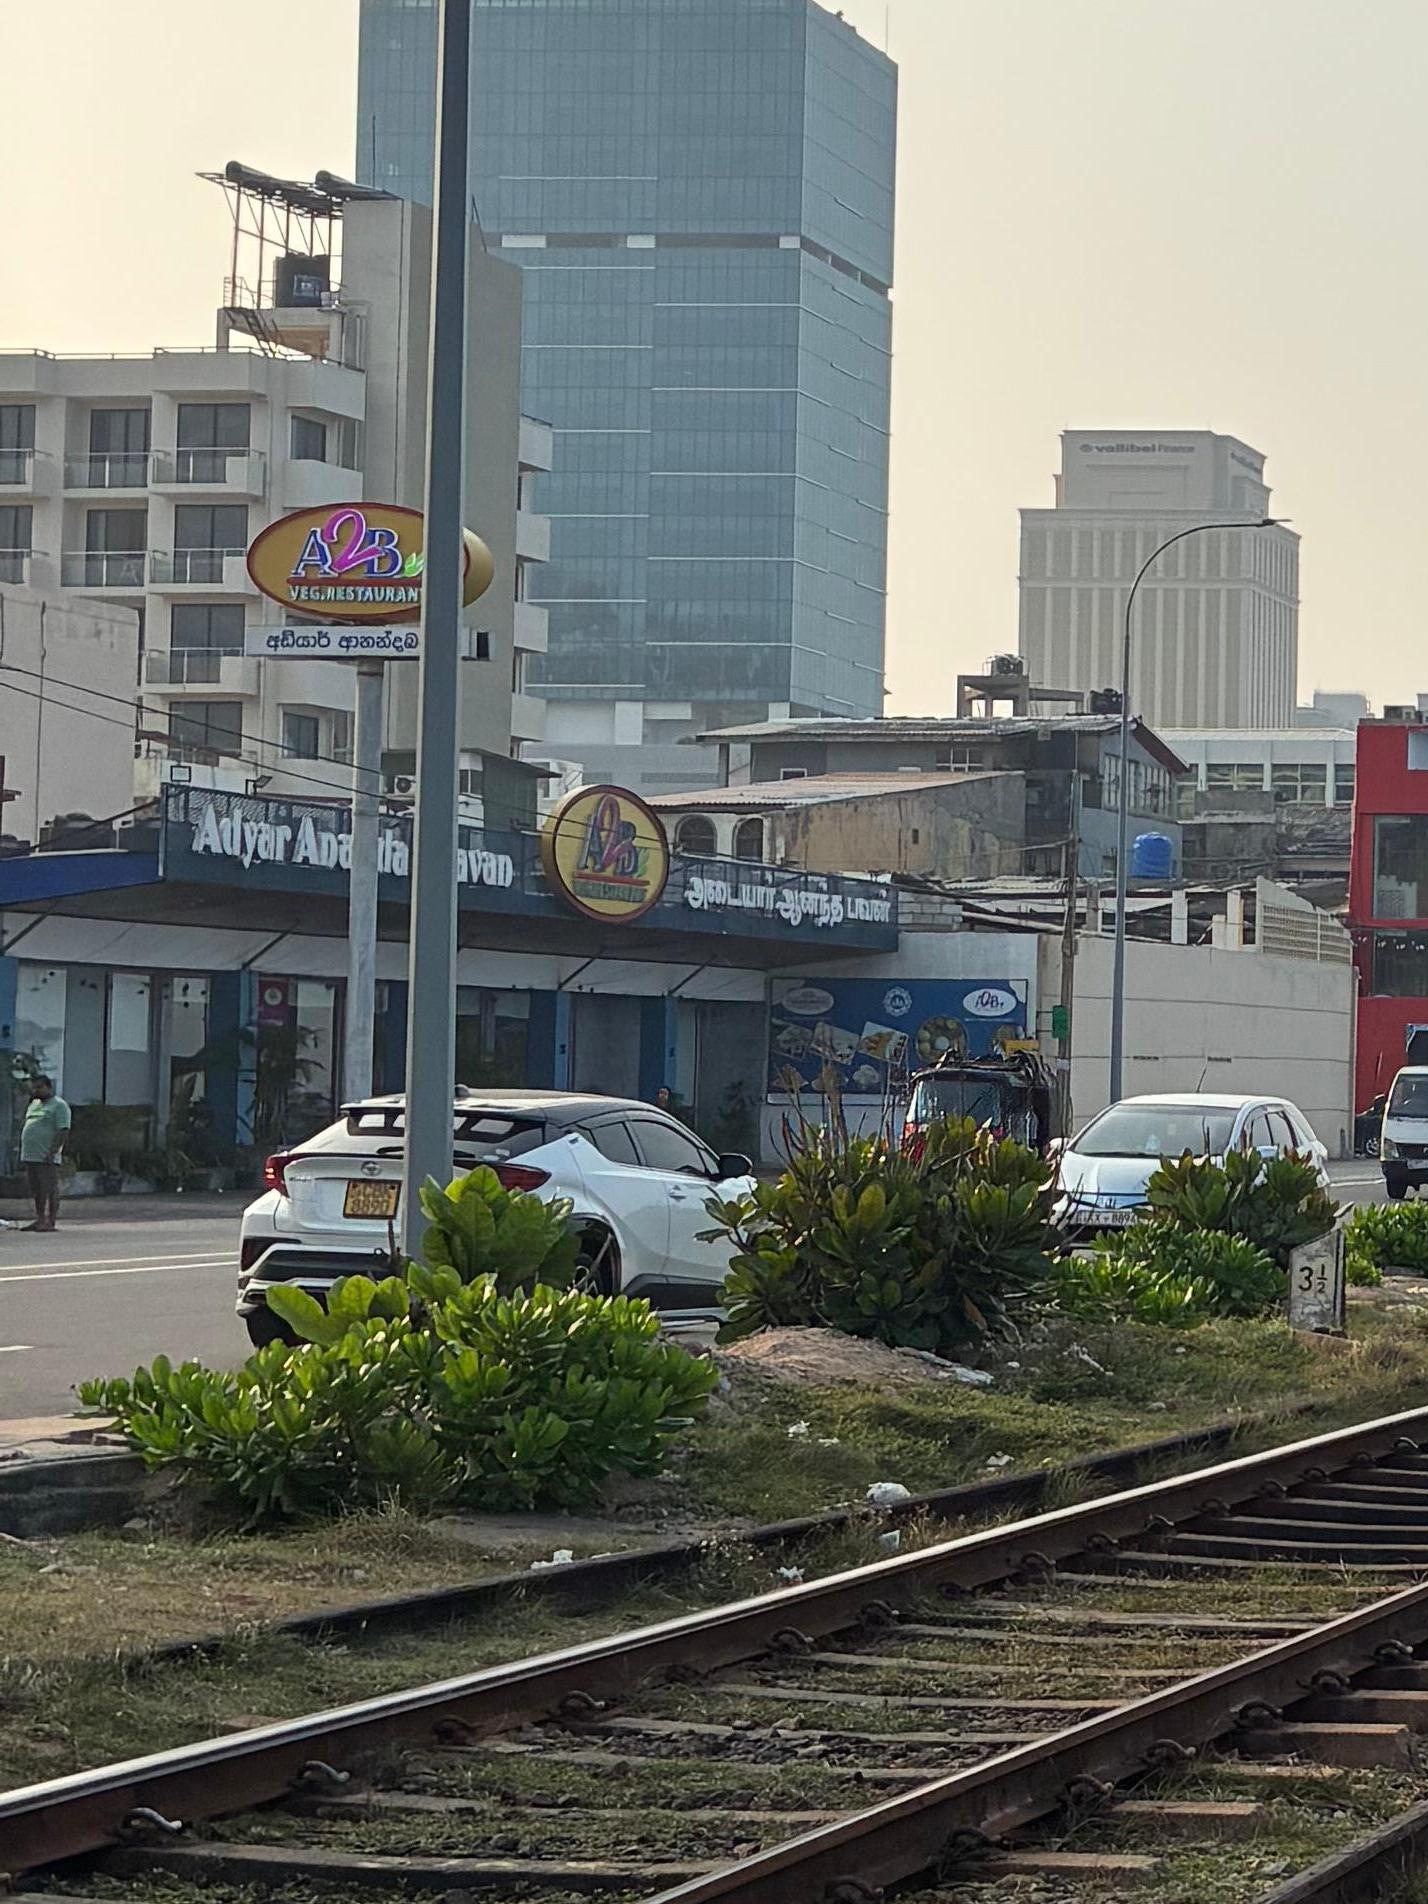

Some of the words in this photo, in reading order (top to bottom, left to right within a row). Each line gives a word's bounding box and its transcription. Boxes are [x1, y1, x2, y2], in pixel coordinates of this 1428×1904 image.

[1095, 442, 1156, 453] vallibel
[289, 507, 404, 578] A2B
[288, 584, 420, 603] VEG.RESTAURAN
[192, 803, 292, 870] Adyar
[293, 814, 409, 876] Anada
[1298, 1265, 1314, 1291] 3
